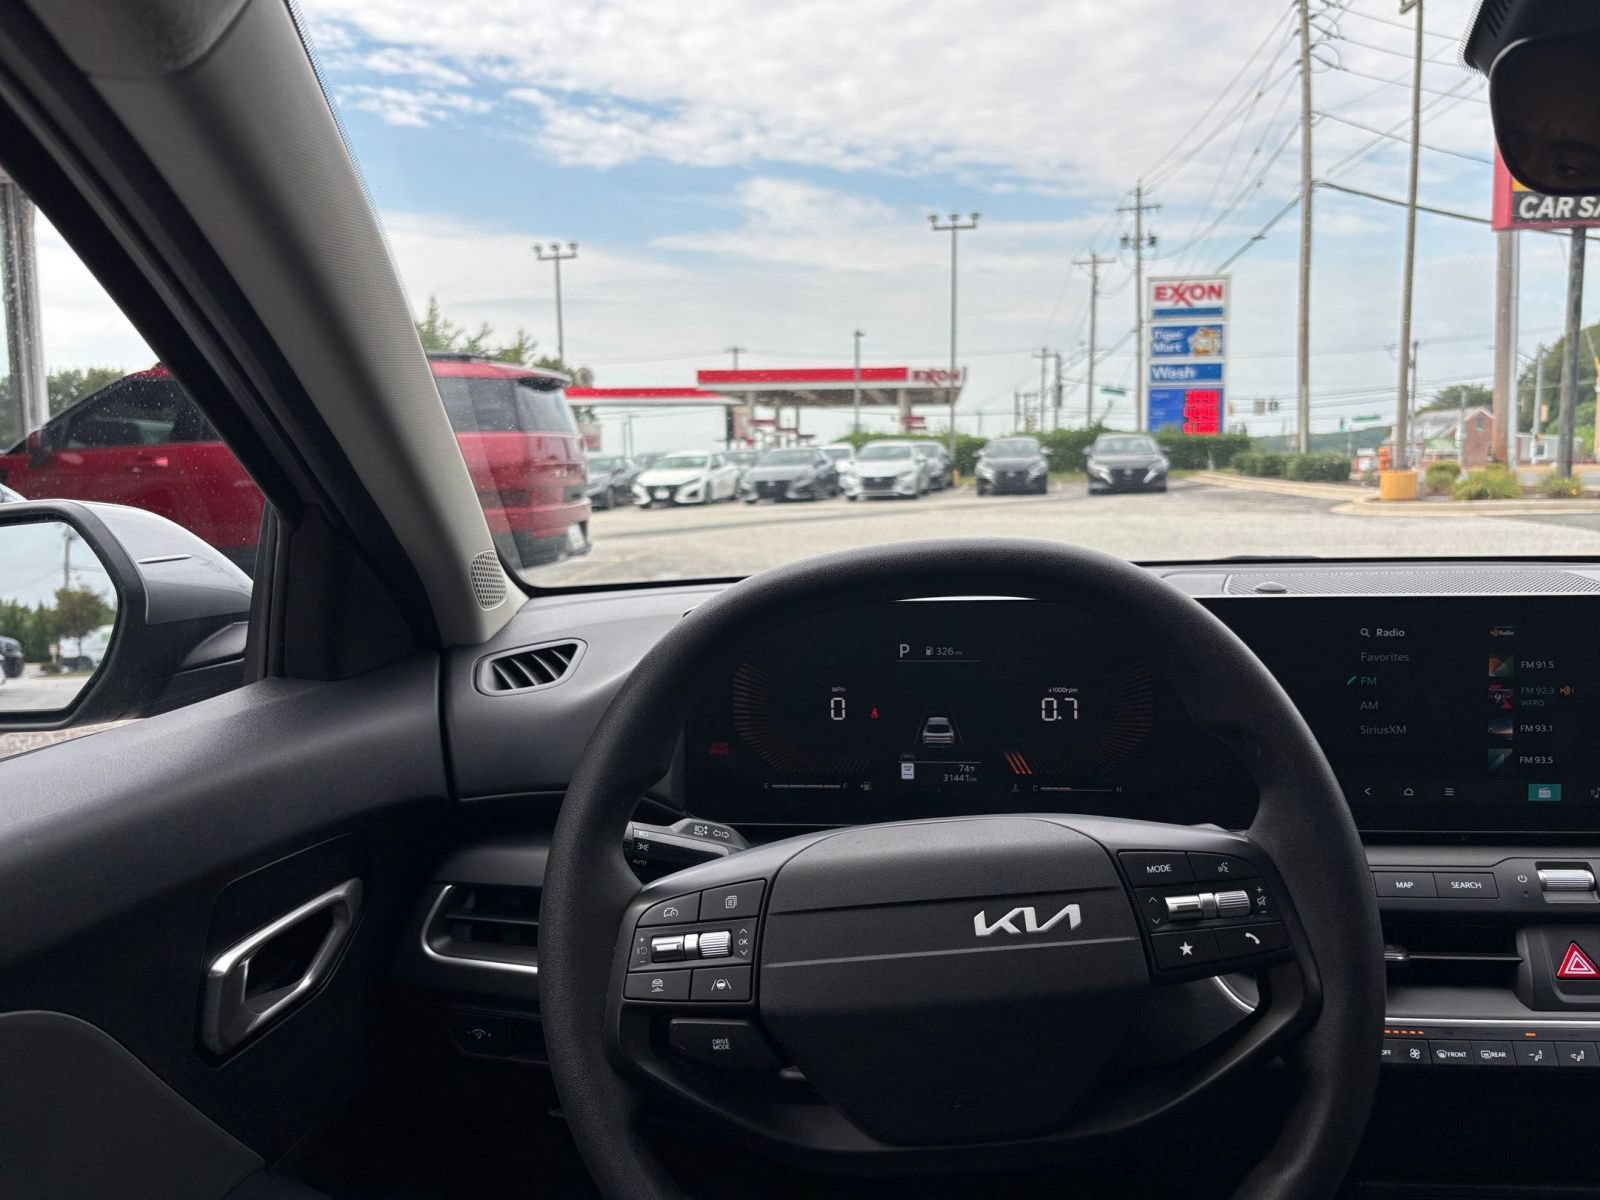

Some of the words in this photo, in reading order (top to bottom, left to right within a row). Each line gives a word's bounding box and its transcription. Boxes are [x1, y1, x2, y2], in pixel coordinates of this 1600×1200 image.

[1519, 195, 1575, 219] CAR
[1154, 283, 1223, 307] EXXON
[1152, 366, 1197, 380] Wash
[1376, 627, 1405, 637] Radio
[899, 643, 911, 659] P
[936, 647, 954, 656] 326
[1360, 652, 1410, 662] Favorites
[1521, 661, 1535, 669] FM
[1535, 661, 1555, 669] 91.5
[1360, 676, 1377, 686] FM
[1520, 687, 1535, 695] FM
[1535, 687, 1555, 695] 92.3
[830, 697, 846, 721] 0
[1041, 697, 1078, 721] 0.7
[1360, 701, 1379, 710] AM
[1360, 725, 1407, 735] SiriusXM
[1520, 724, 1534, 732] FM
[1534, 724, 1553, 732] 93.1
[1519, 756, 1533, 764] FM
[1534, 756, 1554, 764] 93.5
[943, 774, 969, 782] 31441
[1146, 864, 1172, 873] MODE
[1451, 881, 1482, 889] SEARCH
[973, 903, 1082, 937] KIA
[738, 938, 748, 946] OK
